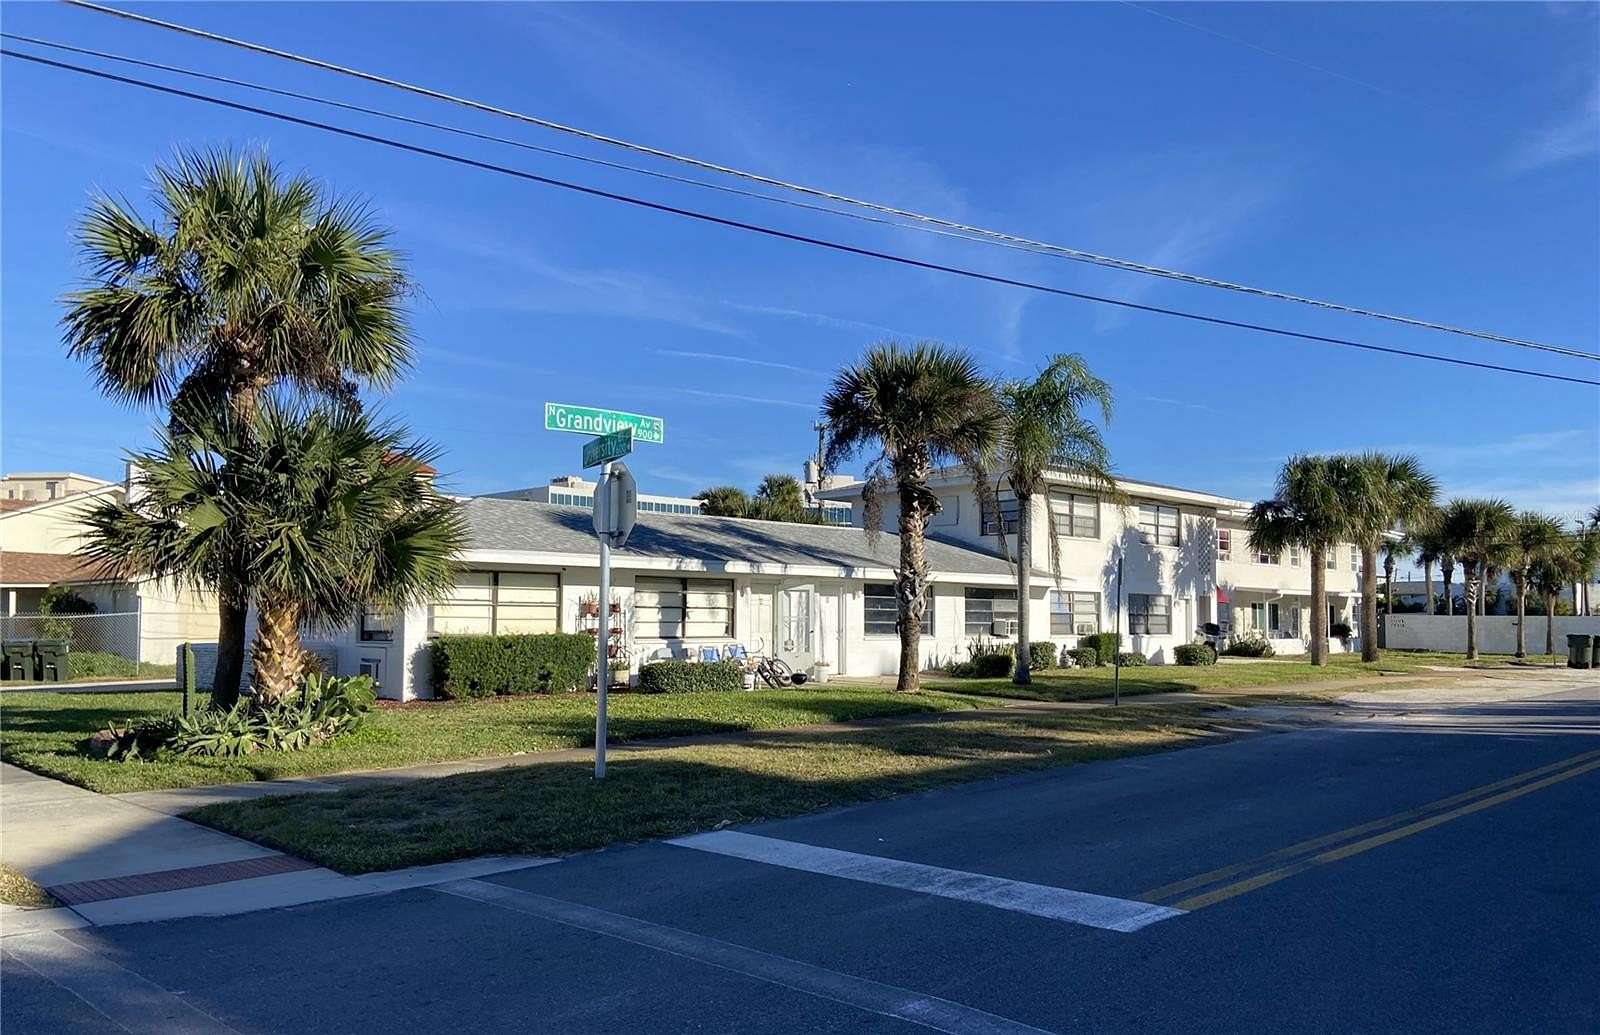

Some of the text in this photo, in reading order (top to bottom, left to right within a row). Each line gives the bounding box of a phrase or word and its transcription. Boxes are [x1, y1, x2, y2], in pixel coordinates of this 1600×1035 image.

[549, 406, 556, 416] N
[556, 408, 637, 436] Grandview
[640, 419, 651, 429] Av
[637, 430, 652, 440] 900
[585, 438, 617, 467] ersity
